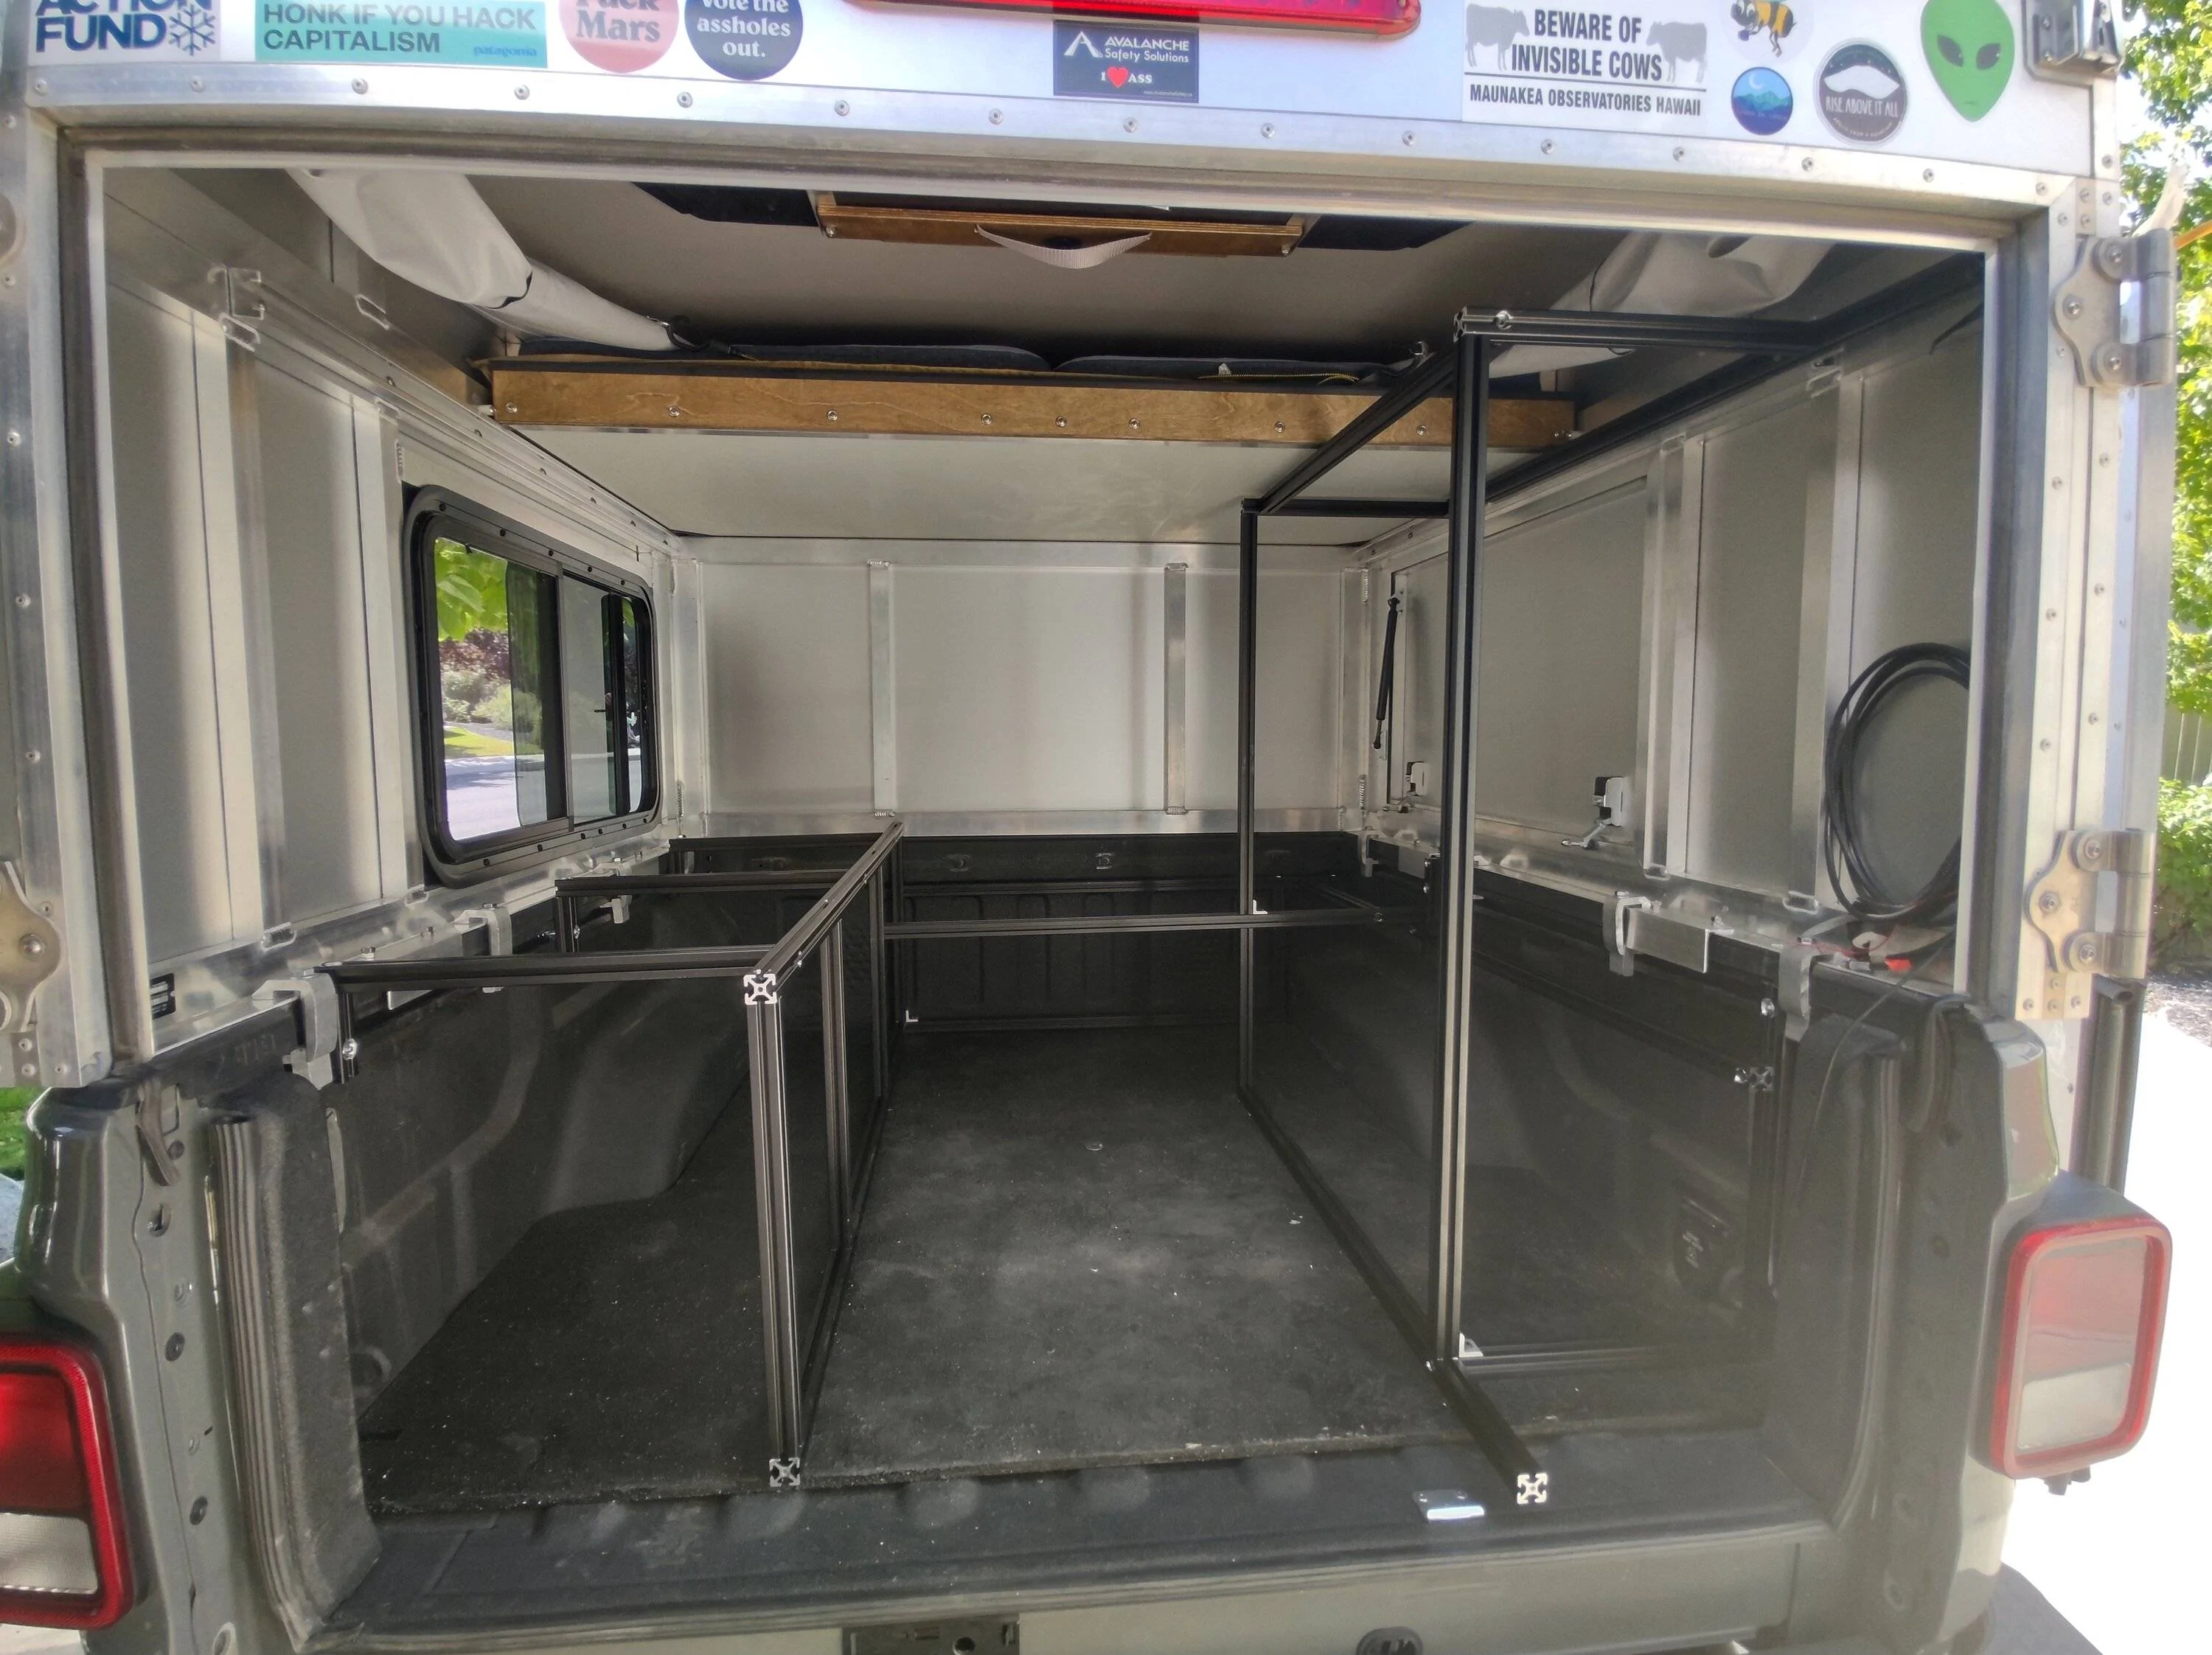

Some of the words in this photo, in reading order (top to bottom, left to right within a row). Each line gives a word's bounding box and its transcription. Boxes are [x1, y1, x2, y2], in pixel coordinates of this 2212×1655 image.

[263, 4, 347, 25] HONK
[354, 5, 377, 25] IF
[385, 5, 445, 27] YOU
[453, 7, 538, 30] HACK
[576, 10, 661, 43] Mars
[697, 15, 791, 37] assholes
[1534, 9, 1613, 41] BEWARE
[1618, 16, 1642, 43] OF
[35, 13, 167, 53] FUND
[263, 29, 441, 53] CAPITALISM
[1105, 36, 1189, 52] AVALANCHE
[473, 44, 538, 58] patagonia
[723, 41, 766, 58] out.
[1105, 48, 1141, 63] Safety
[1144, 50, 1189, 63] Solutions
[1512, 44, 1602, 77] INVISIBLE
[1609, 51, 1663, 80] COWS
[1100, 71, 1106, 81] I
[1127, 72, 1152, 84] ASS
[1470, 84, 1544, 106] MAUNAKEA
[1548, 88, 1652, 112] OBSERVATORIES
[1656, 96, 1702, 116] HAWAII
[1825, 96, 1843, 113] RISE
[1845, 97, 1874, 116] ABOVE
[1874, 100, 1884, 116] IT
[1884, 101, 1899, 118] ALL
